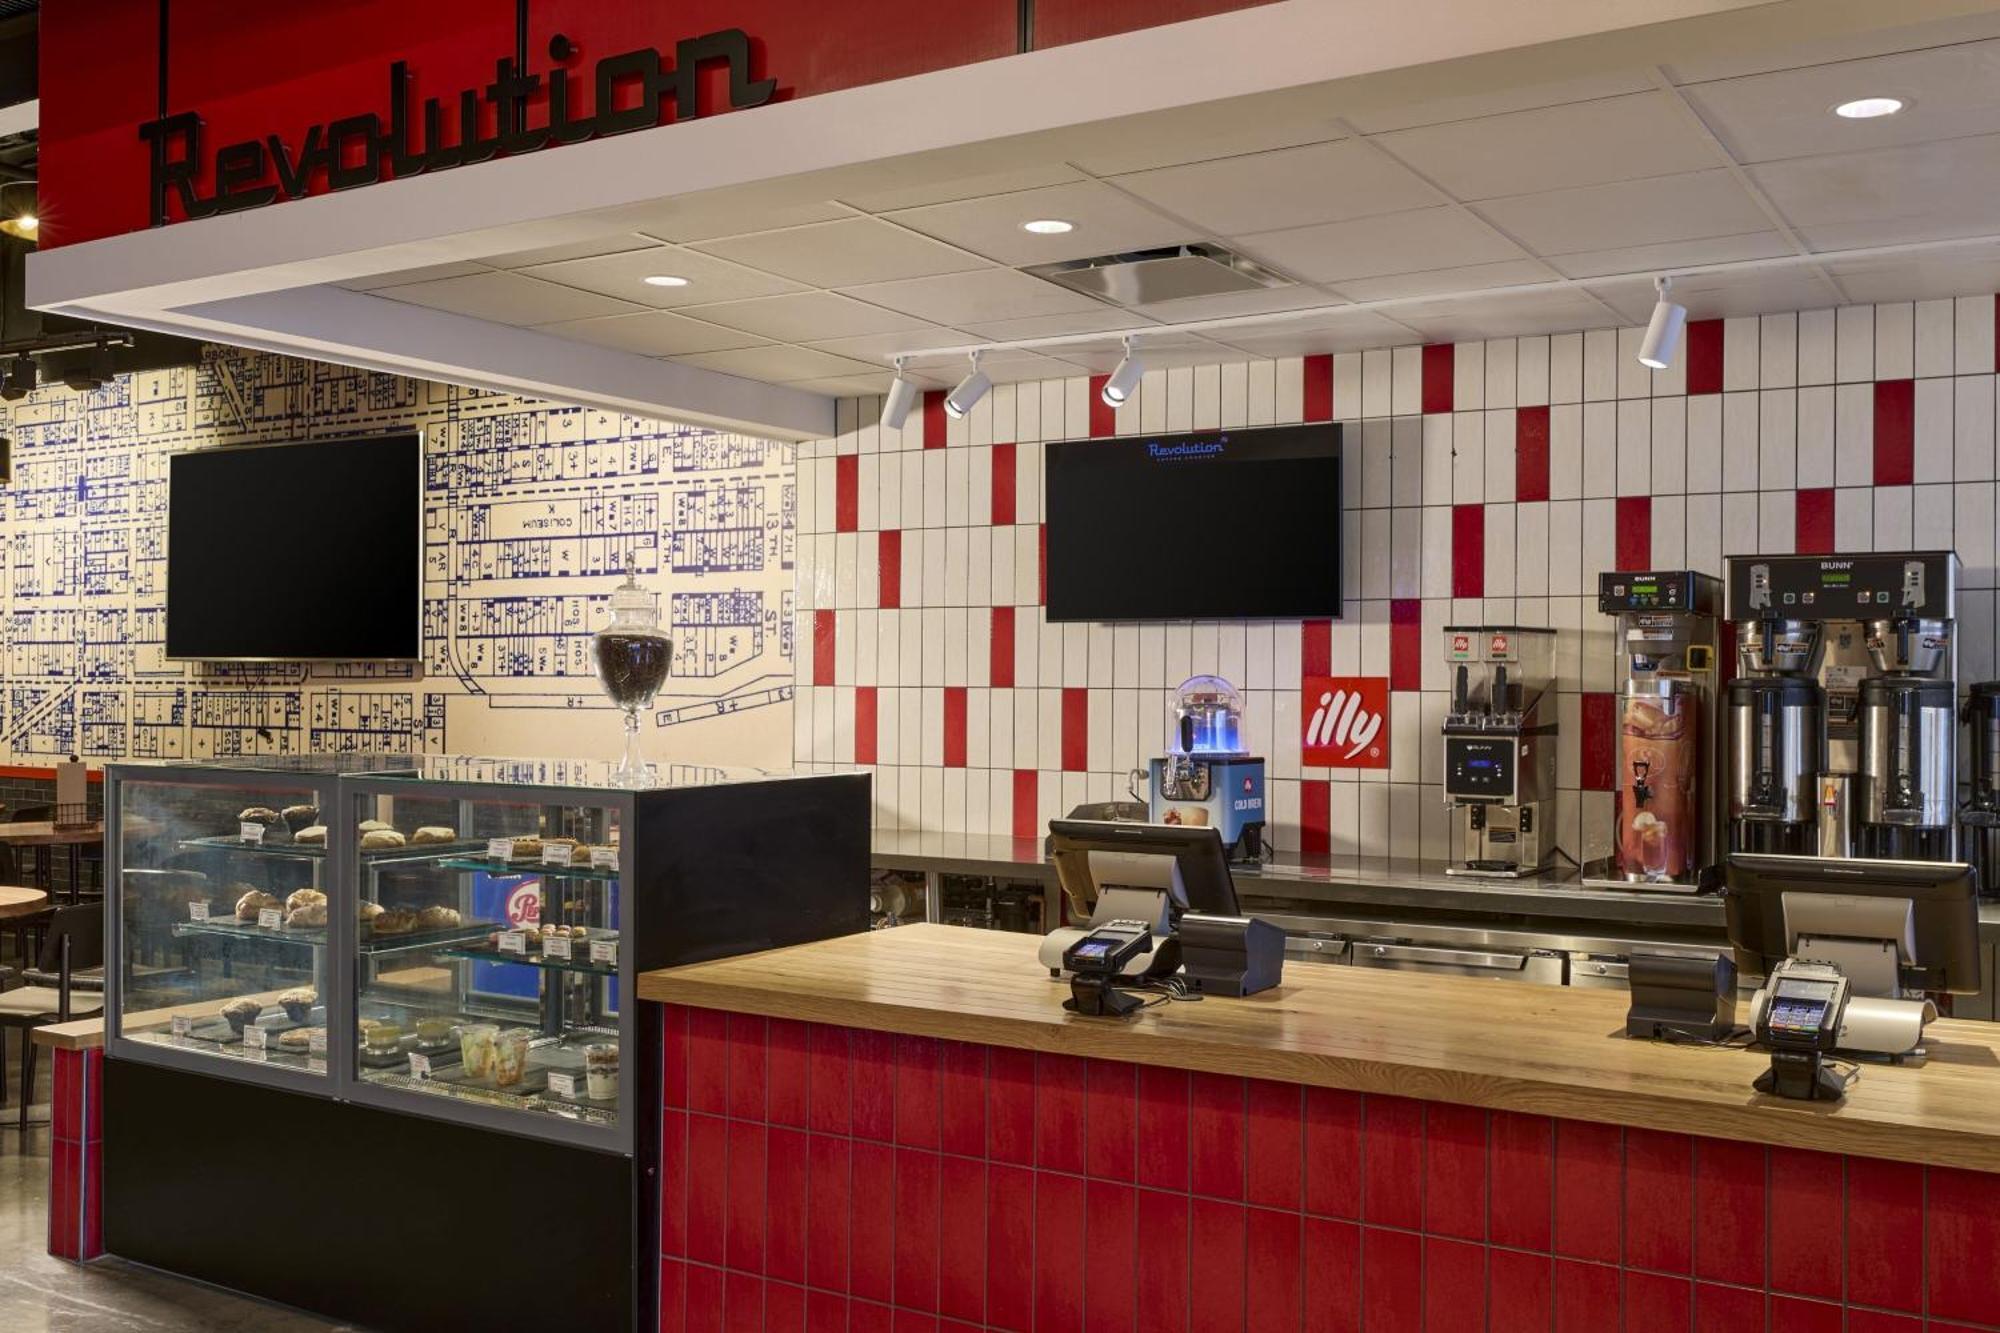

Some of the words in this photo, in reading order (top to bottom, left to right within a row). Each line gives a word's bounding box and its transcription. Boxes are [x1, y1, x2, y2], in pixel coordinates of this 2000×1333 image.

[139, 27, 778, 227] Revolution
[1148, 442, 1224, 456] Revolution
[522, 518, 572, 528] COLISEUM
[1821, 562, 1851, 570] BUNN
[765, 610, 776, 638] ST.
[1306, 689, 1382, 759] illy
